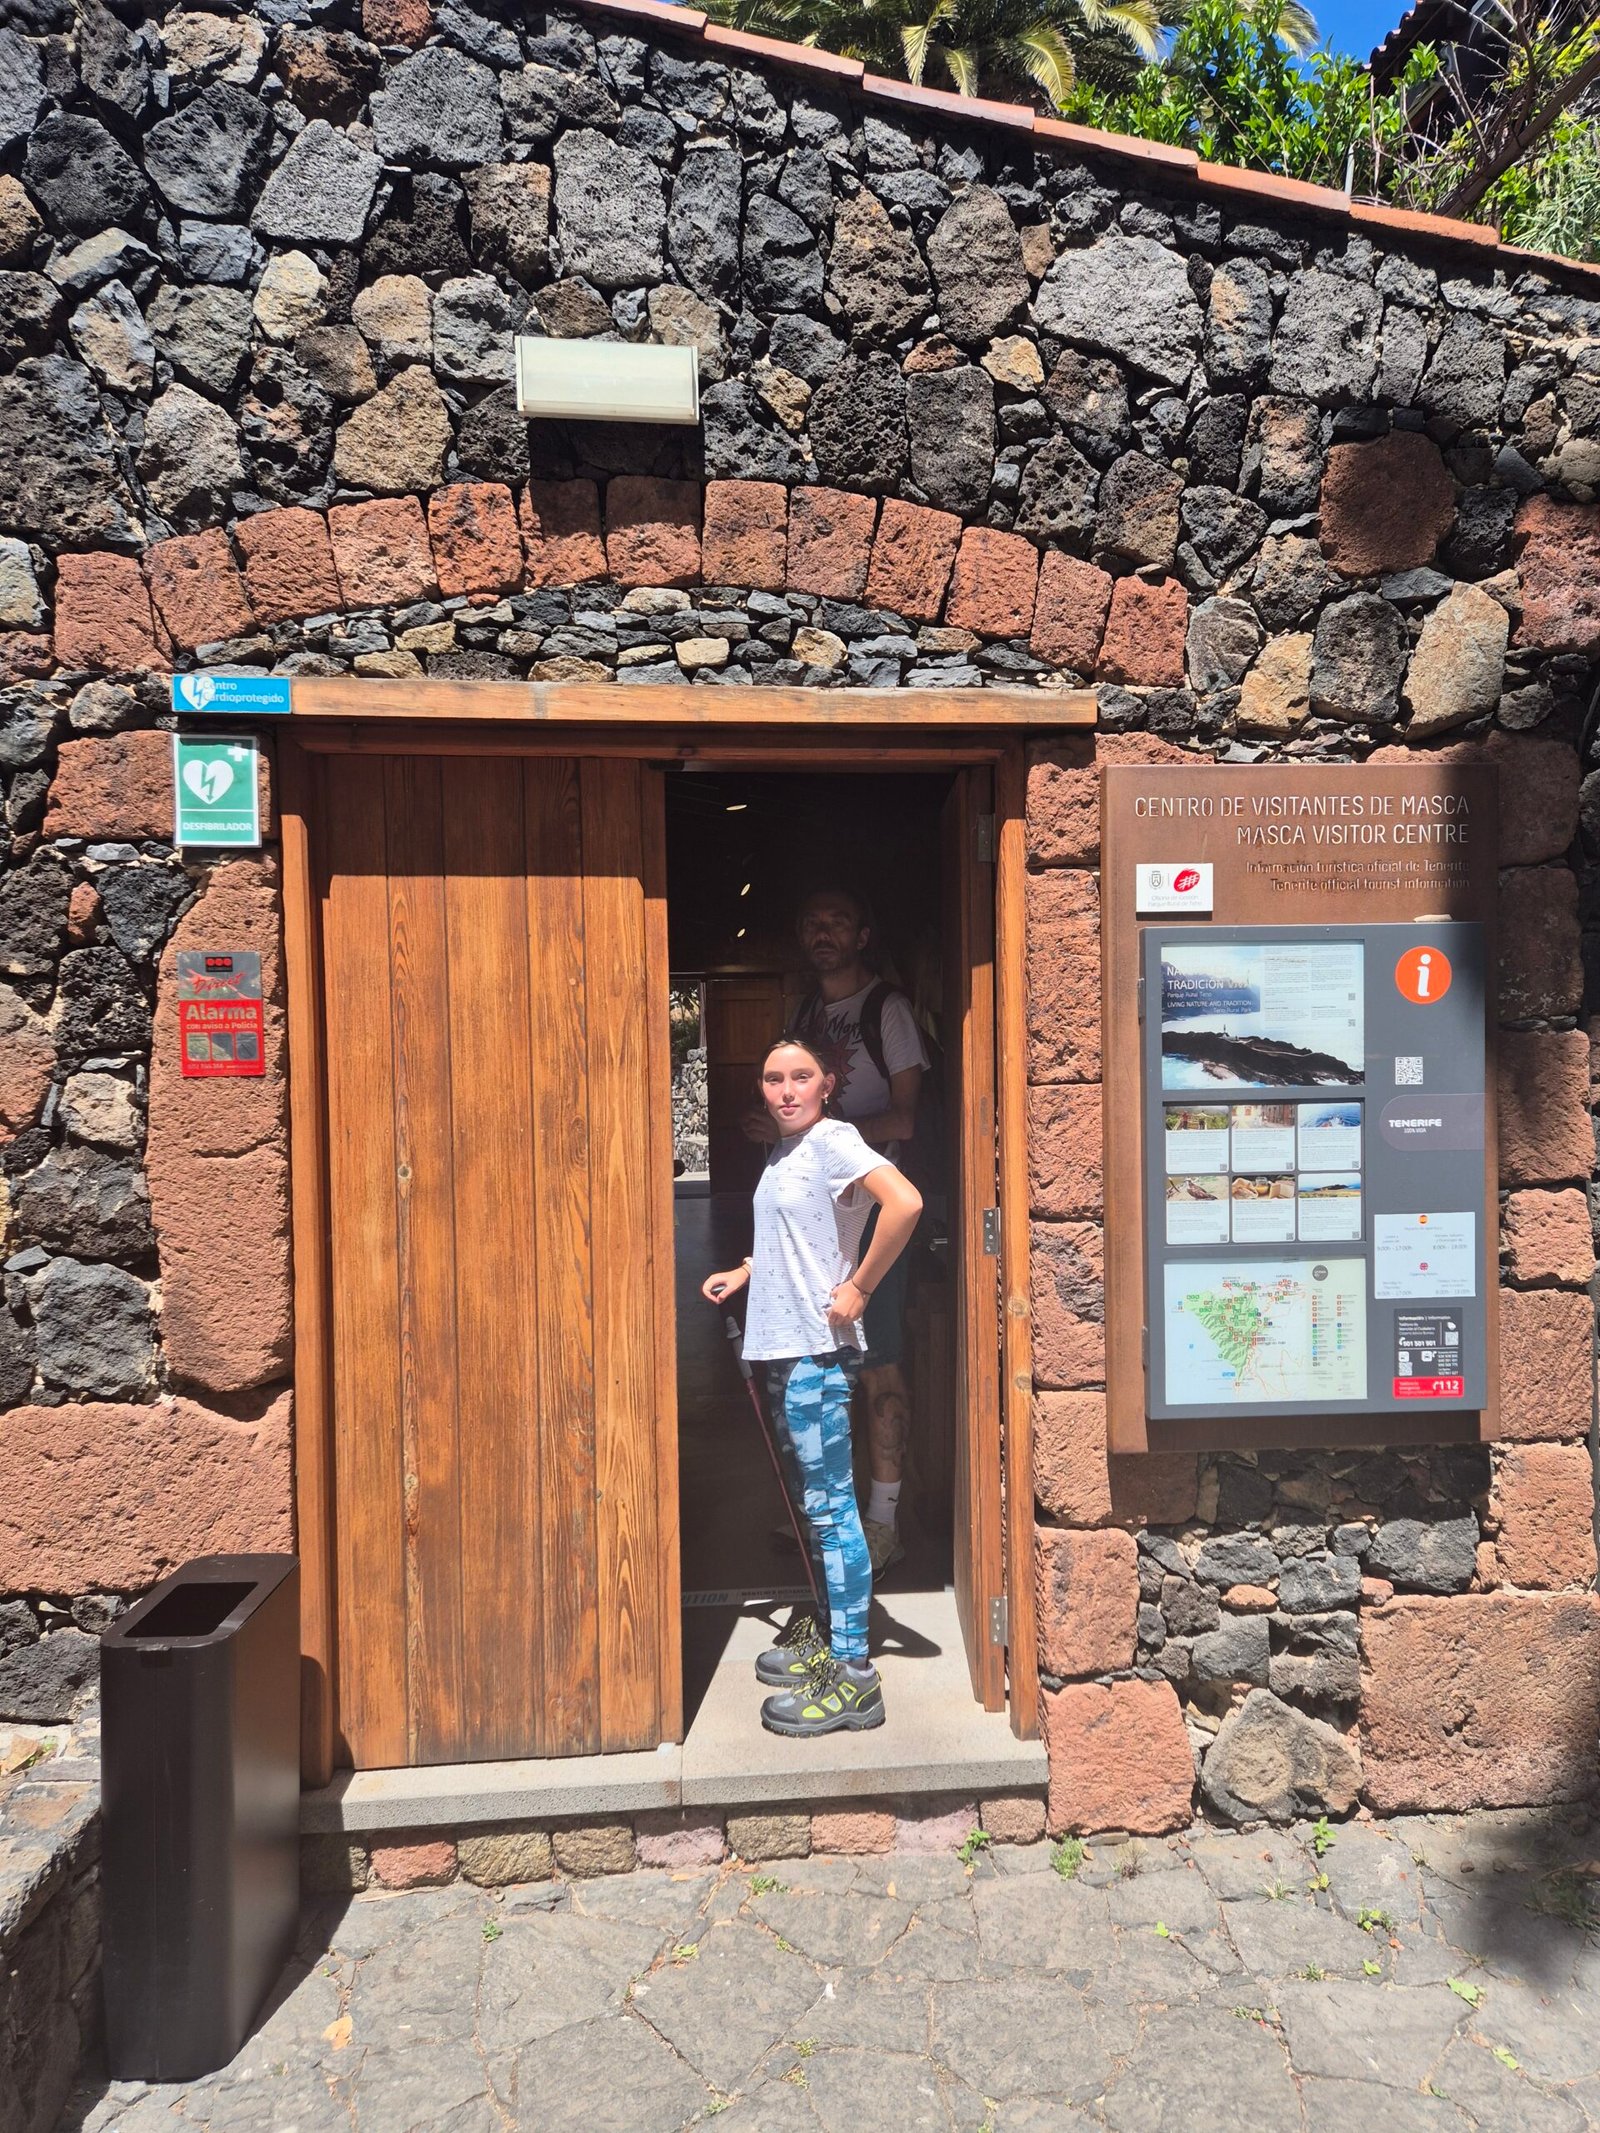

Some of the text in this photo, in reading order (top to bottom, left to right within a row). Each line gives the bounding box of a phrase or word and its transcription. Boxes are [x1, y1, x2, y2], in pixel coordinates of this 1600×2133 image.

[1135, 795, 1470, 817] CENTRO DE VISITANTES DE MASCA
[182, 822, 254, 831] DESFIBRILADOR
[1237, 824, 1470, 845] MASCA VISITOR CENTRE
[1246, 860, 1314, 874] Información
[1367, 859, 1402, 872] oficial
[1405, 859, 1420, 872] de
[1424, 859, 1470, 872] Tenerife
[1270, 877, 1470, 891] Tenerife official tourist information
[1167, 978, 1224, 990] TRADICIÓN
[186, 1003, 257, 1020] Alarma
[186, 1022, 201, 1030] con
[202, 1021, 223, 1029] aviso
[1388, 1118, 1443, 1128] TENERIFE
[1440, 1380, 1459, 1390] 112
